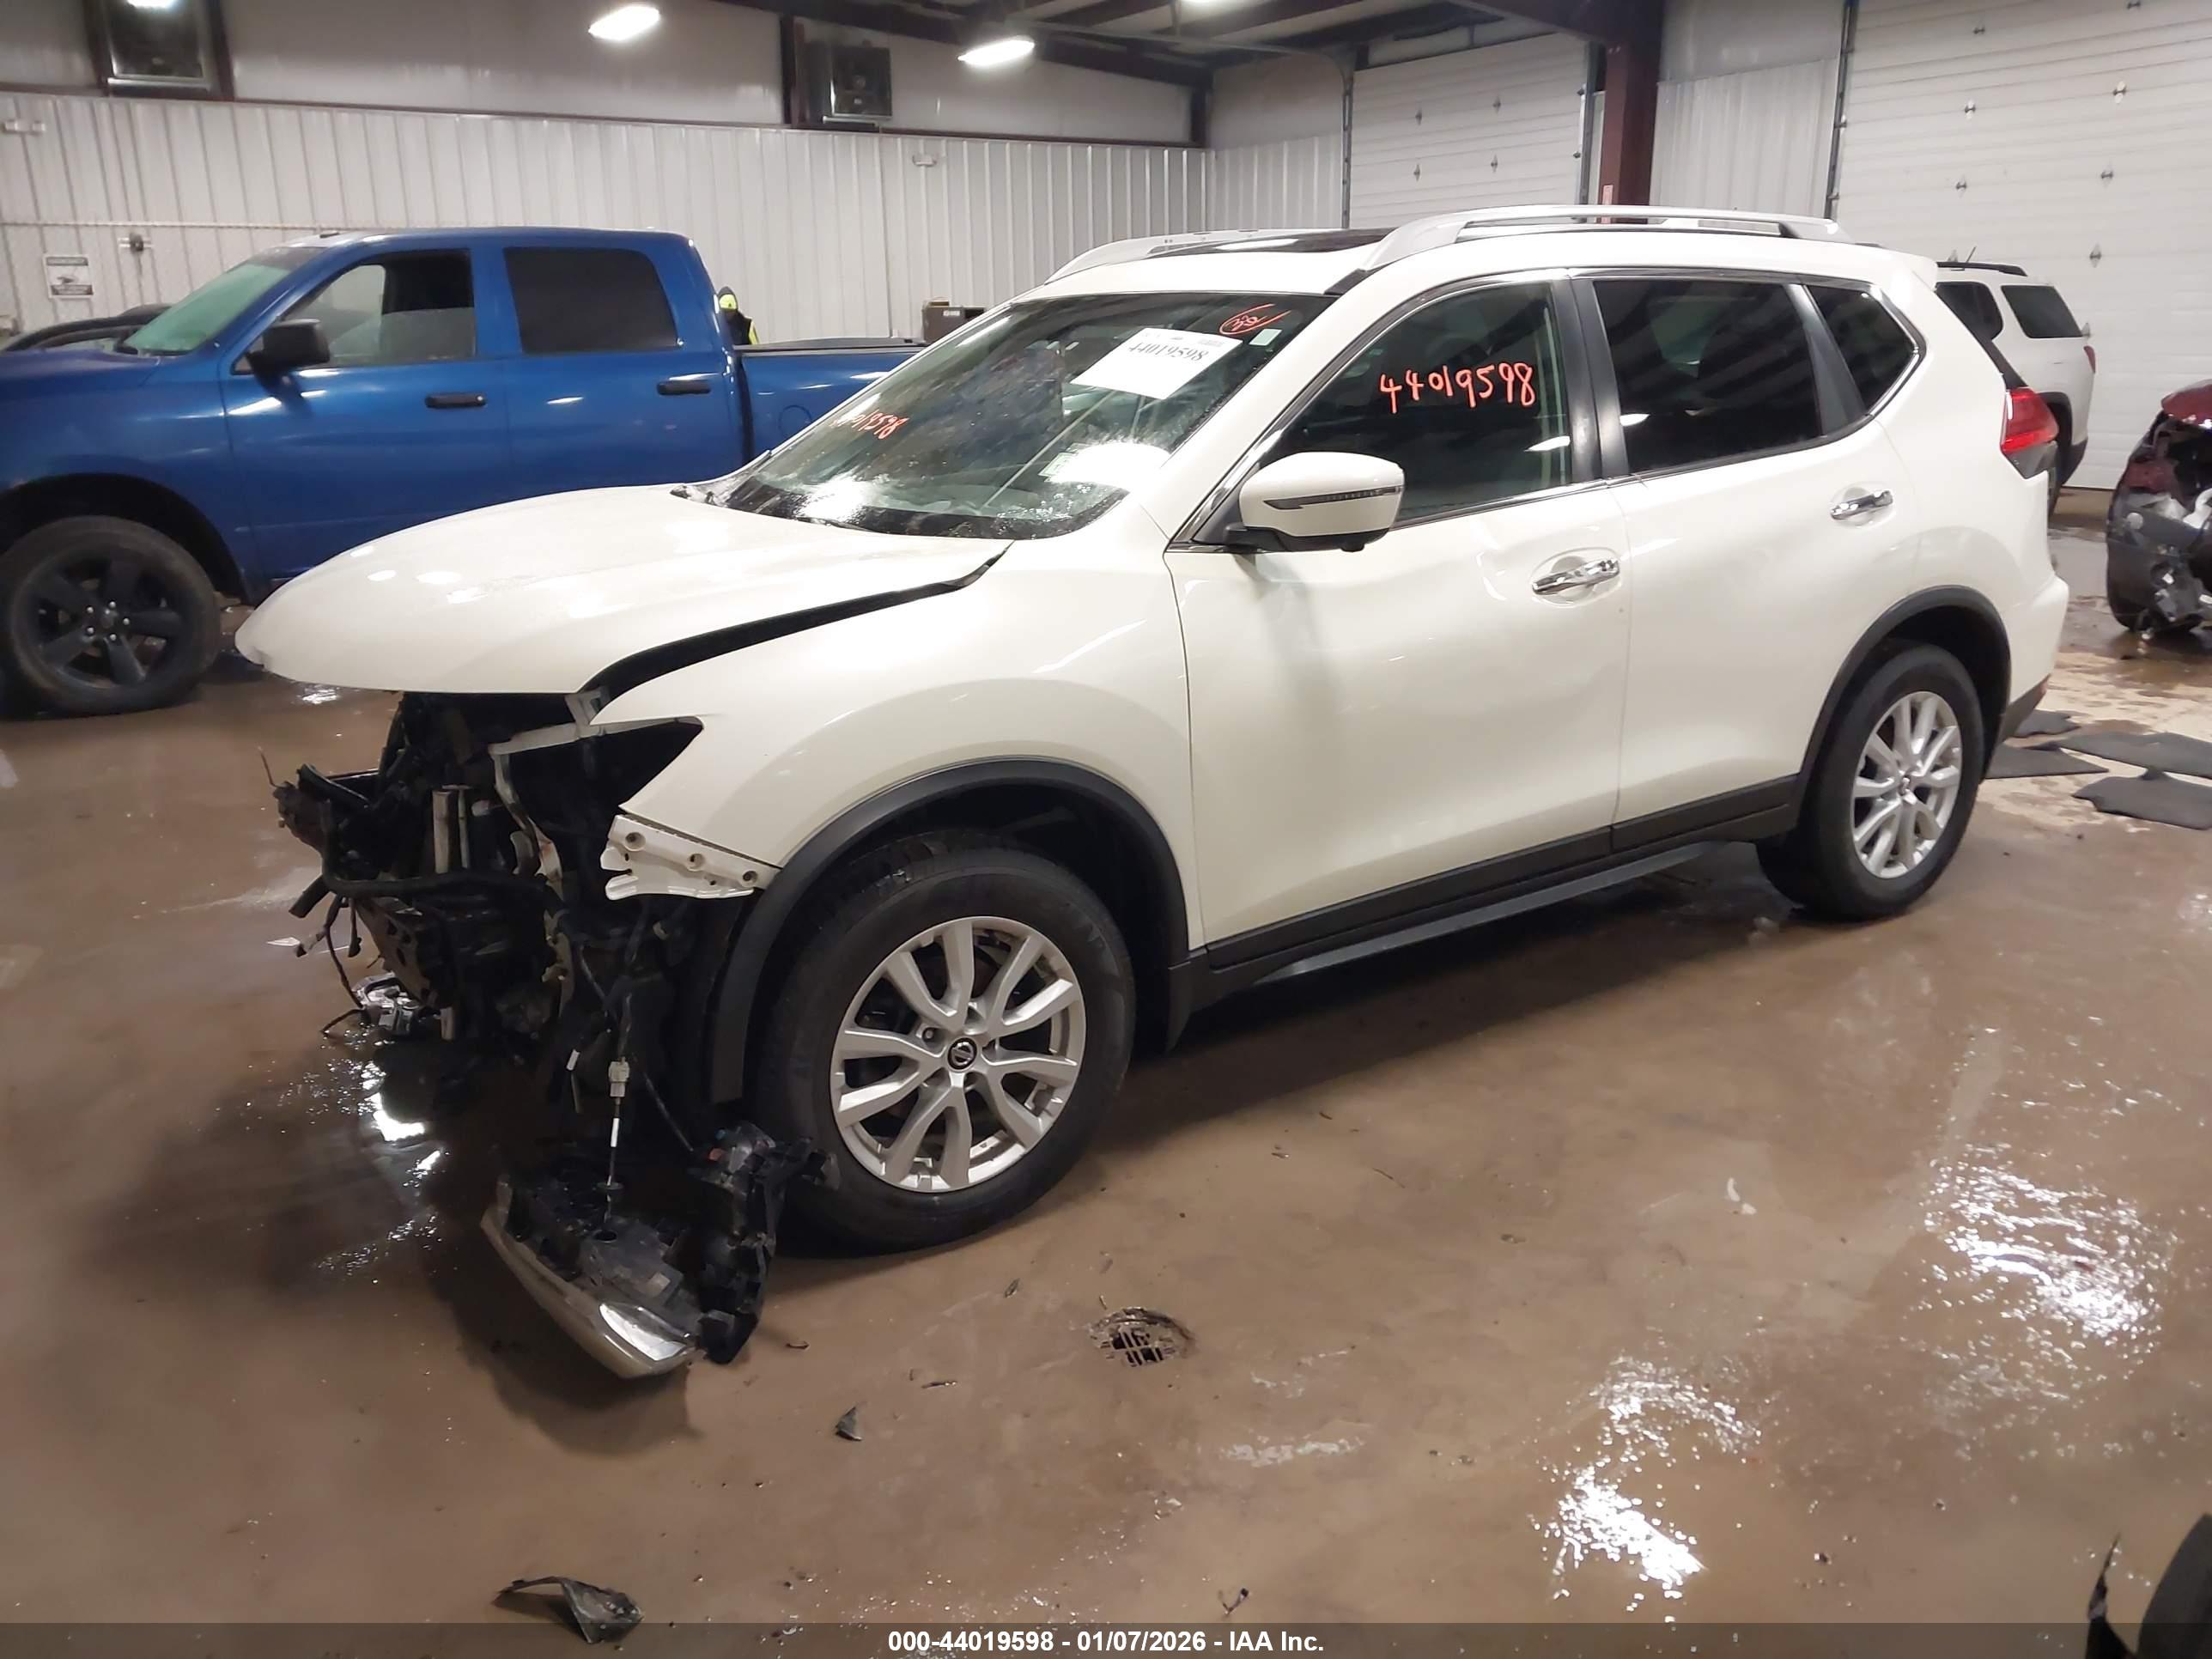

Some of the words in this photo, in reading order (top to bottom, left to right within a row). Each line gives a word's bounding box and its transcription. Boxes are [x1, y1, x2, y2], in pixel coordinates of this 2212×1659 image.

[1128, 342, 1209, 362] 44019598
[1379, 362, 1536, 414] 44019598
[829, 409, 910, 440] 019598
